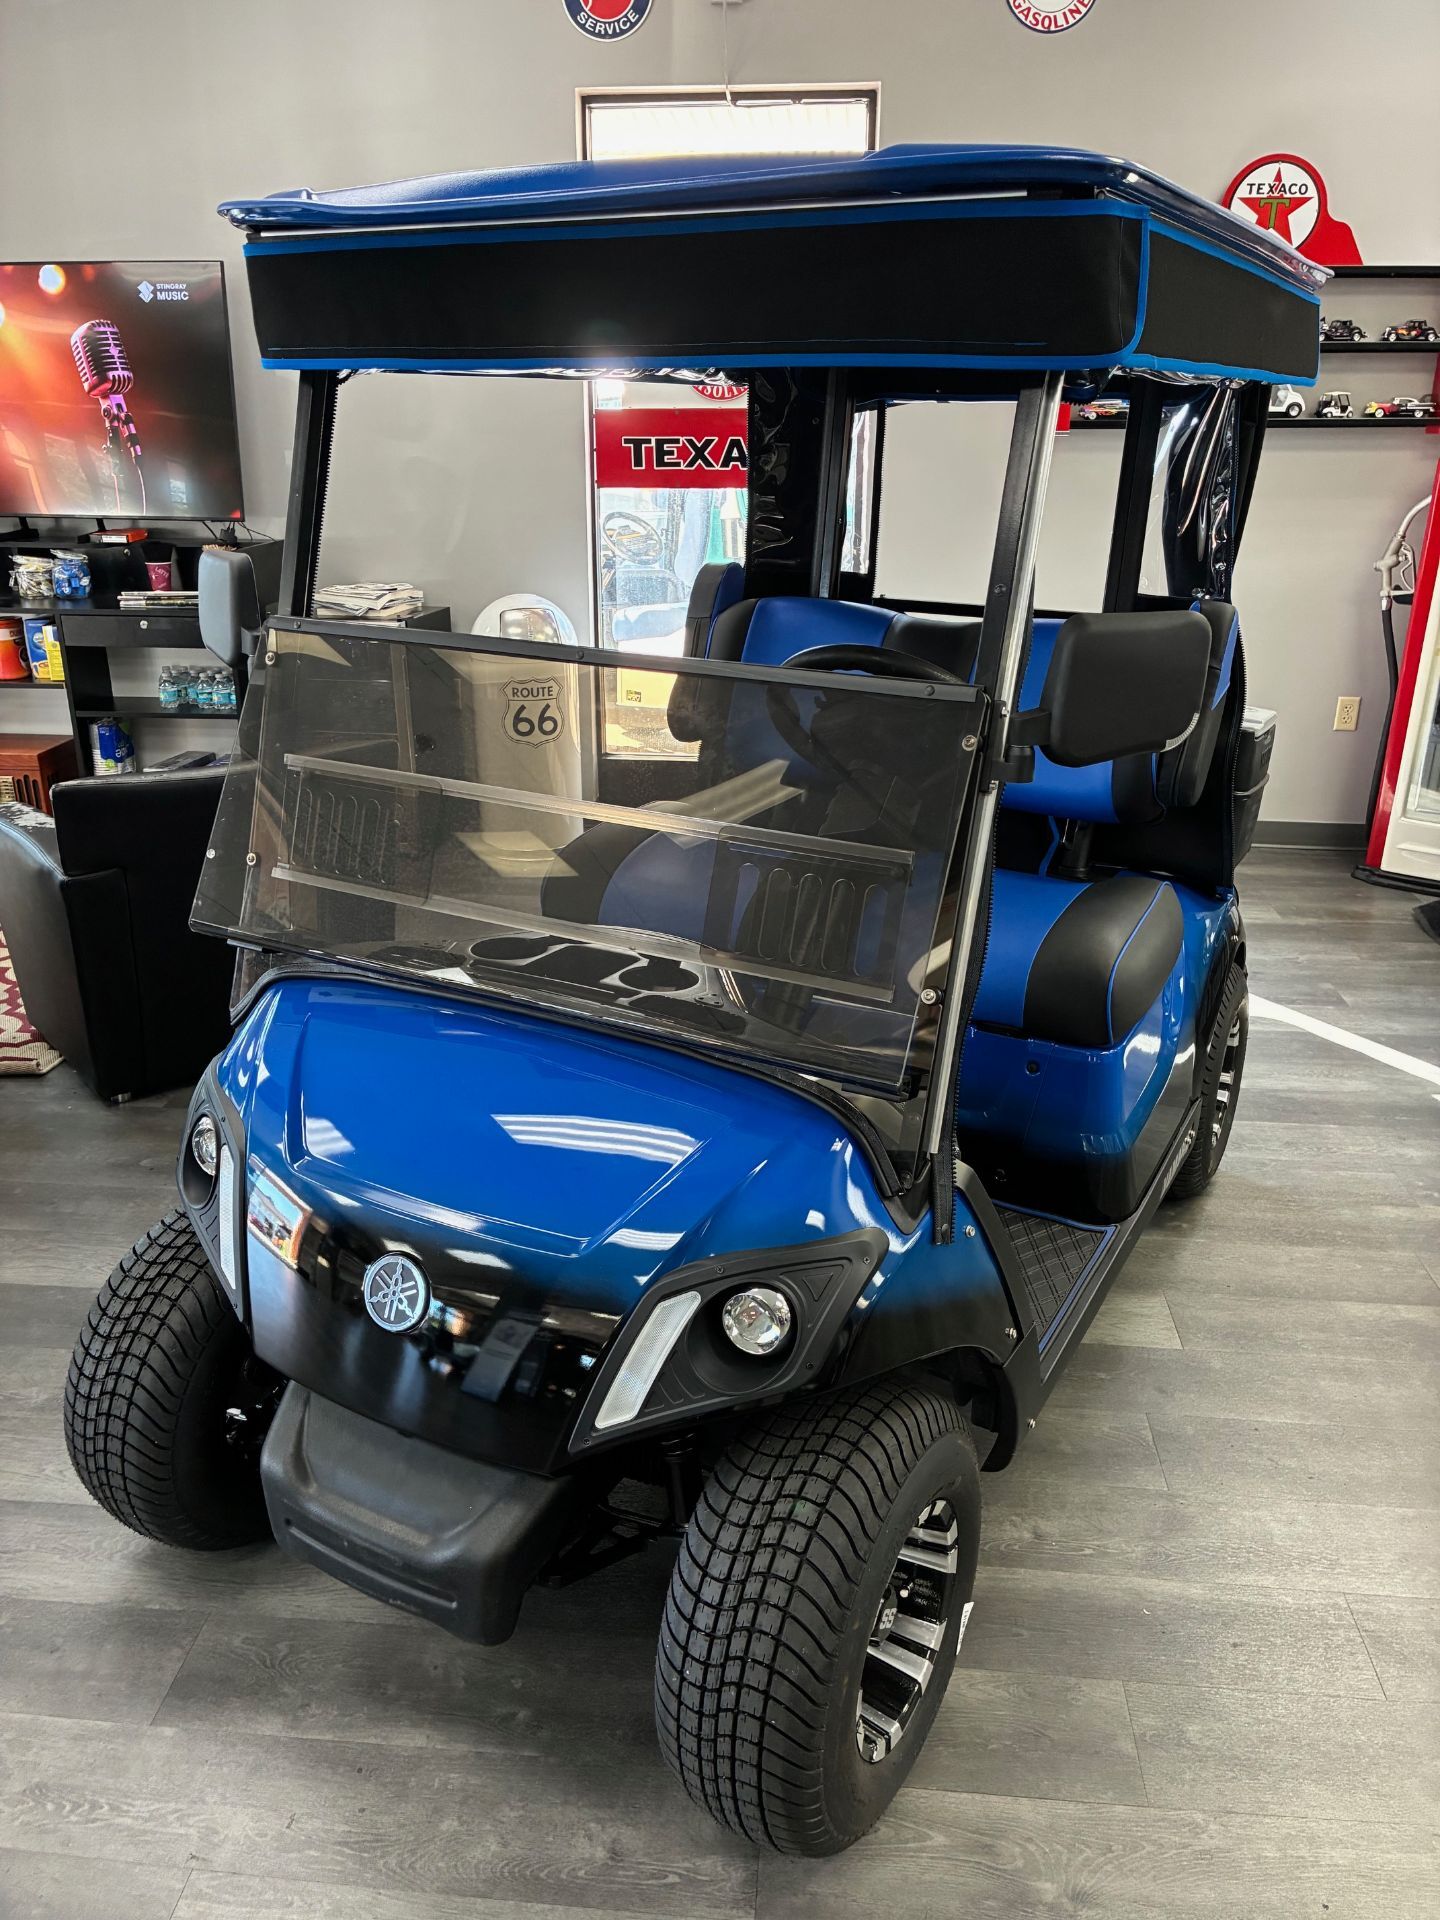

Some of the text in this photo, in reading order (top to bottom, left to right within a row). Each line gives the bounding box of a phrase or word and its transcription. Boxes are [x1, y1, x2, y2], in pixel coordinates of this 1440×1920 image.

[577, 9, 640, 35] SERVICE
[1012, 0, 1091, 30] GASOLINE
[1246, 183, 1309, 196] TEXACO
[156, 291, 189, 301] MUSIC
[512, 685, 554, 699] ROUTE
[512, 703, 558, 737] 66
